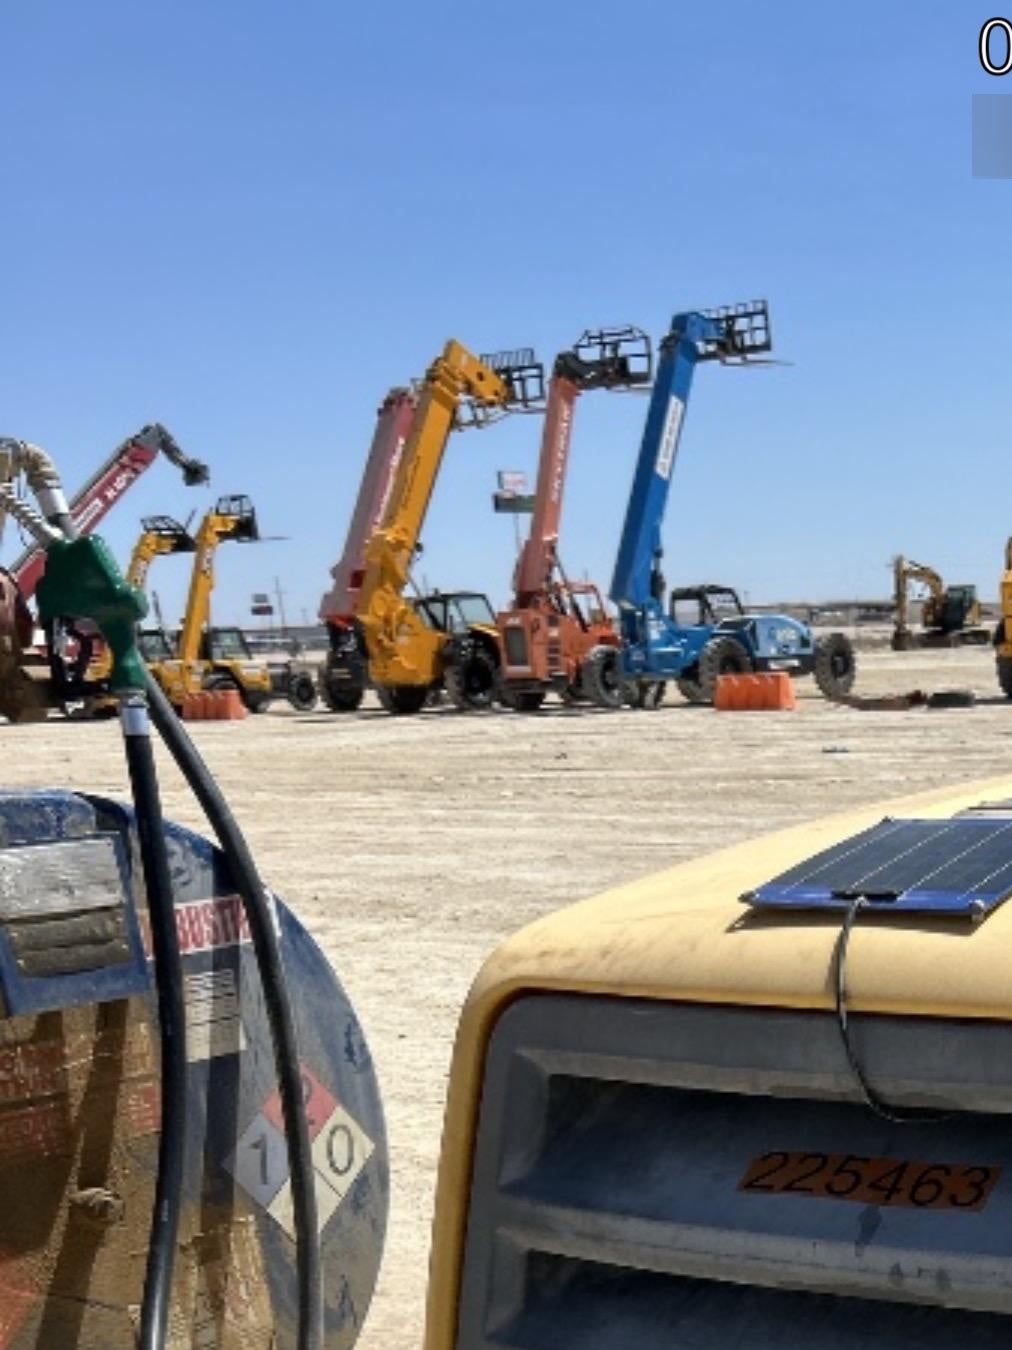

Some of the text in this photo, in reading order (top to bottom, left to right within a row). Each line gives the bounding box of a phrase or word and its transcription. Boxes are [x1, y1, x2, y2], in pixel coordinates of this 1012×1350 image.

[249, 1124, 355, 1186] 1 0
[743, 1150, 992, 1207] 225463
